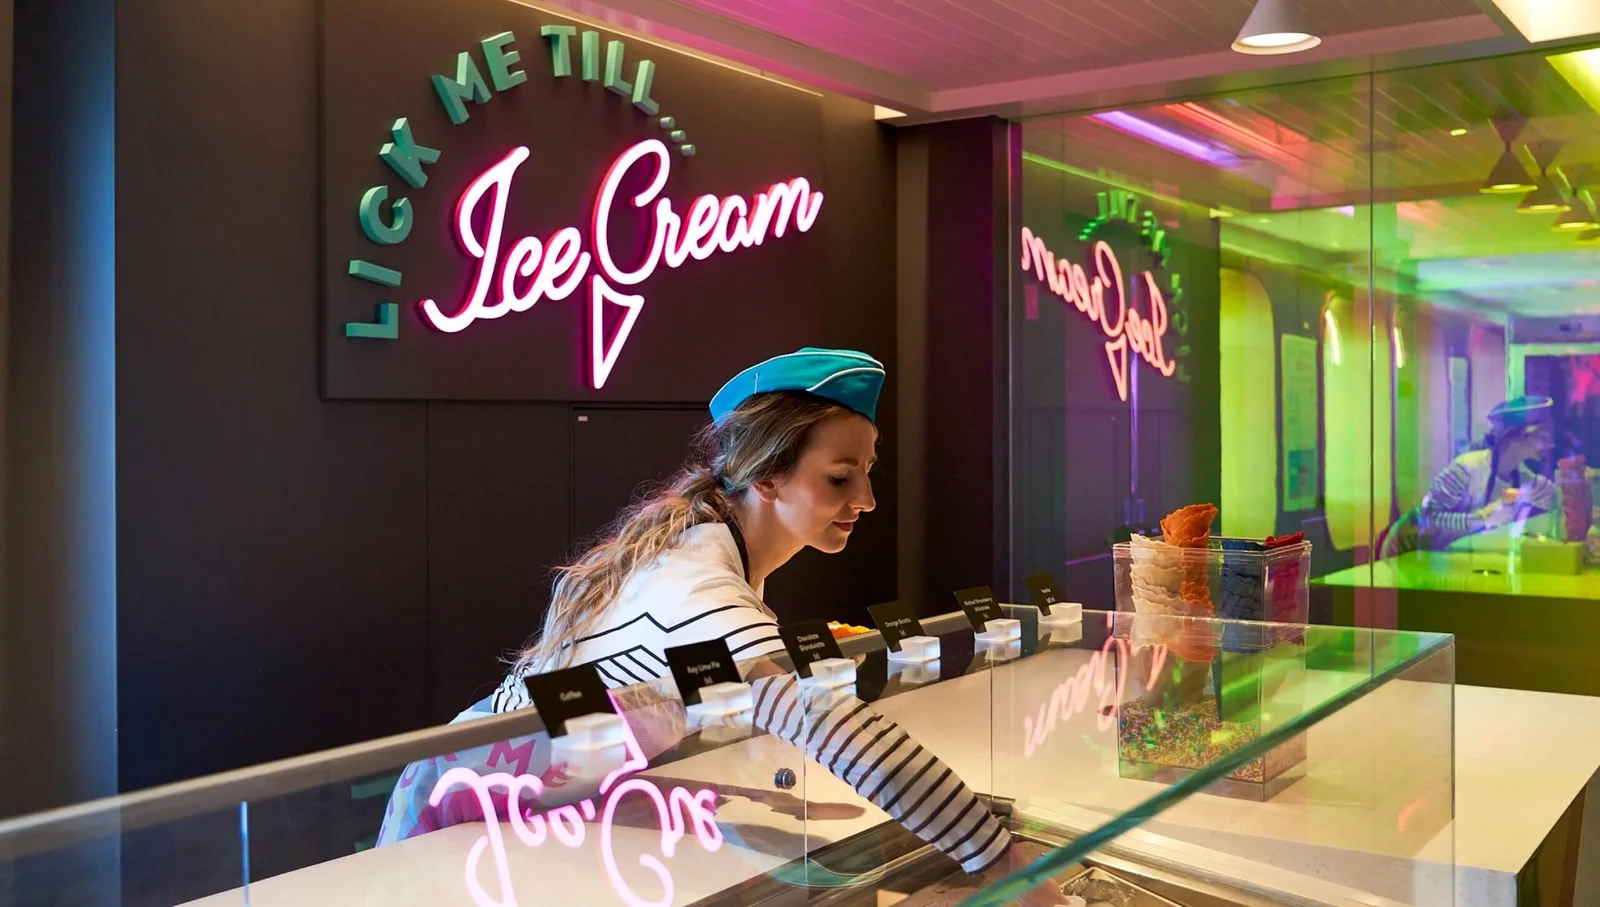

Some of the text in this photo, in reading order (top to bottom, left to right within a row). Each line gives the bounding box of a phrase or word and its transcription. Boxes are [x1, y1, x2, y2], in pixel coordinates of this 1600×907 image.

[345, 116, 441, 340] LICK
[431, 30, 528, 125] ME
[418, 138, 824, 333] Ice Cream
[559, 690, 583, 702] Coffee
[686, 661, 721, 675] Key Lime Pie
